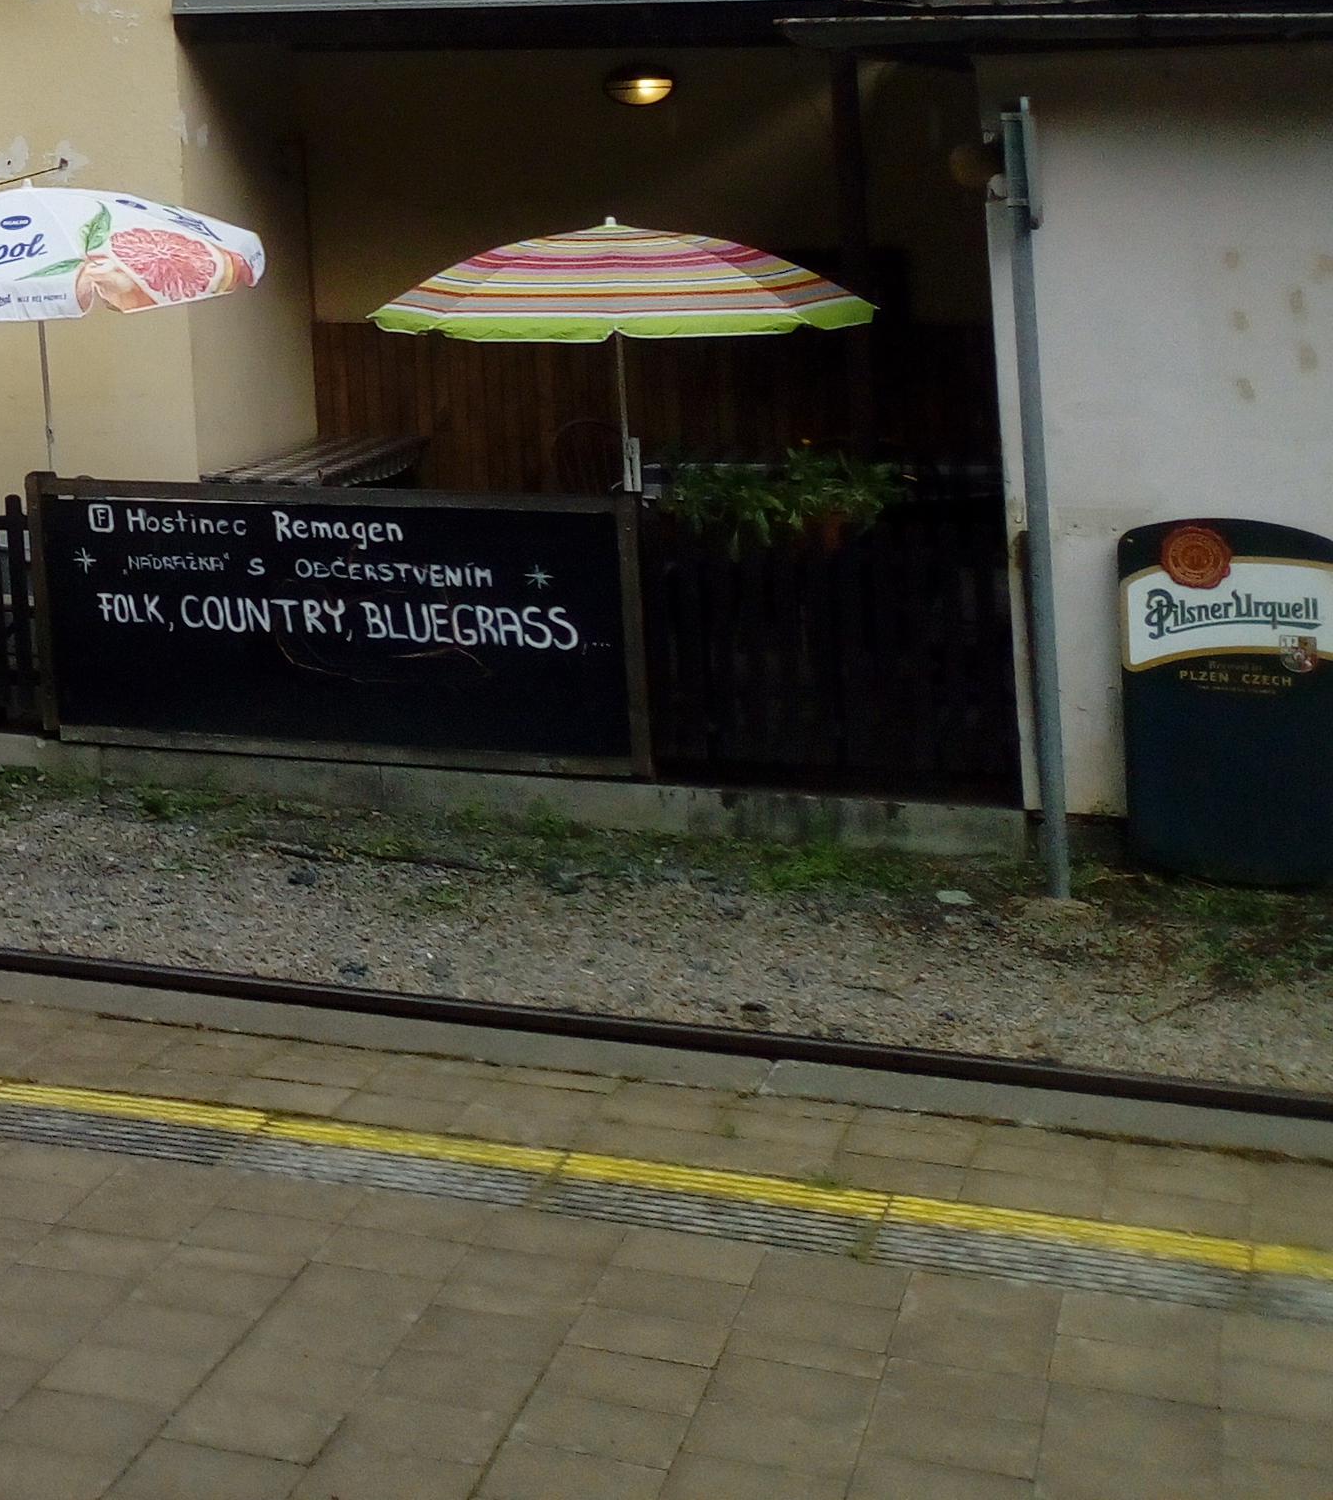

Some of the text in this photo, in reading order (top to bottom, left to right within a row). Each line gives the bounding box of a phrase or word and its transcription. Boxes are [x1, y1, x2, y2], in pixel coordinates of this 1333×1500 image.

[126, 508, 247, 536] Hostinec
[271, 510, 404, 550] Remagen
[294, 556, 493, 588] OBČERSTVENÍM
[96, 592, 174, 632] FOLK,
[181, 595, 353, 642] COUNTRY,
[1144, 588, 1319, 640] Pilsner Urquell
[1179, 669, 1293, 687] PLZEN CZECH
